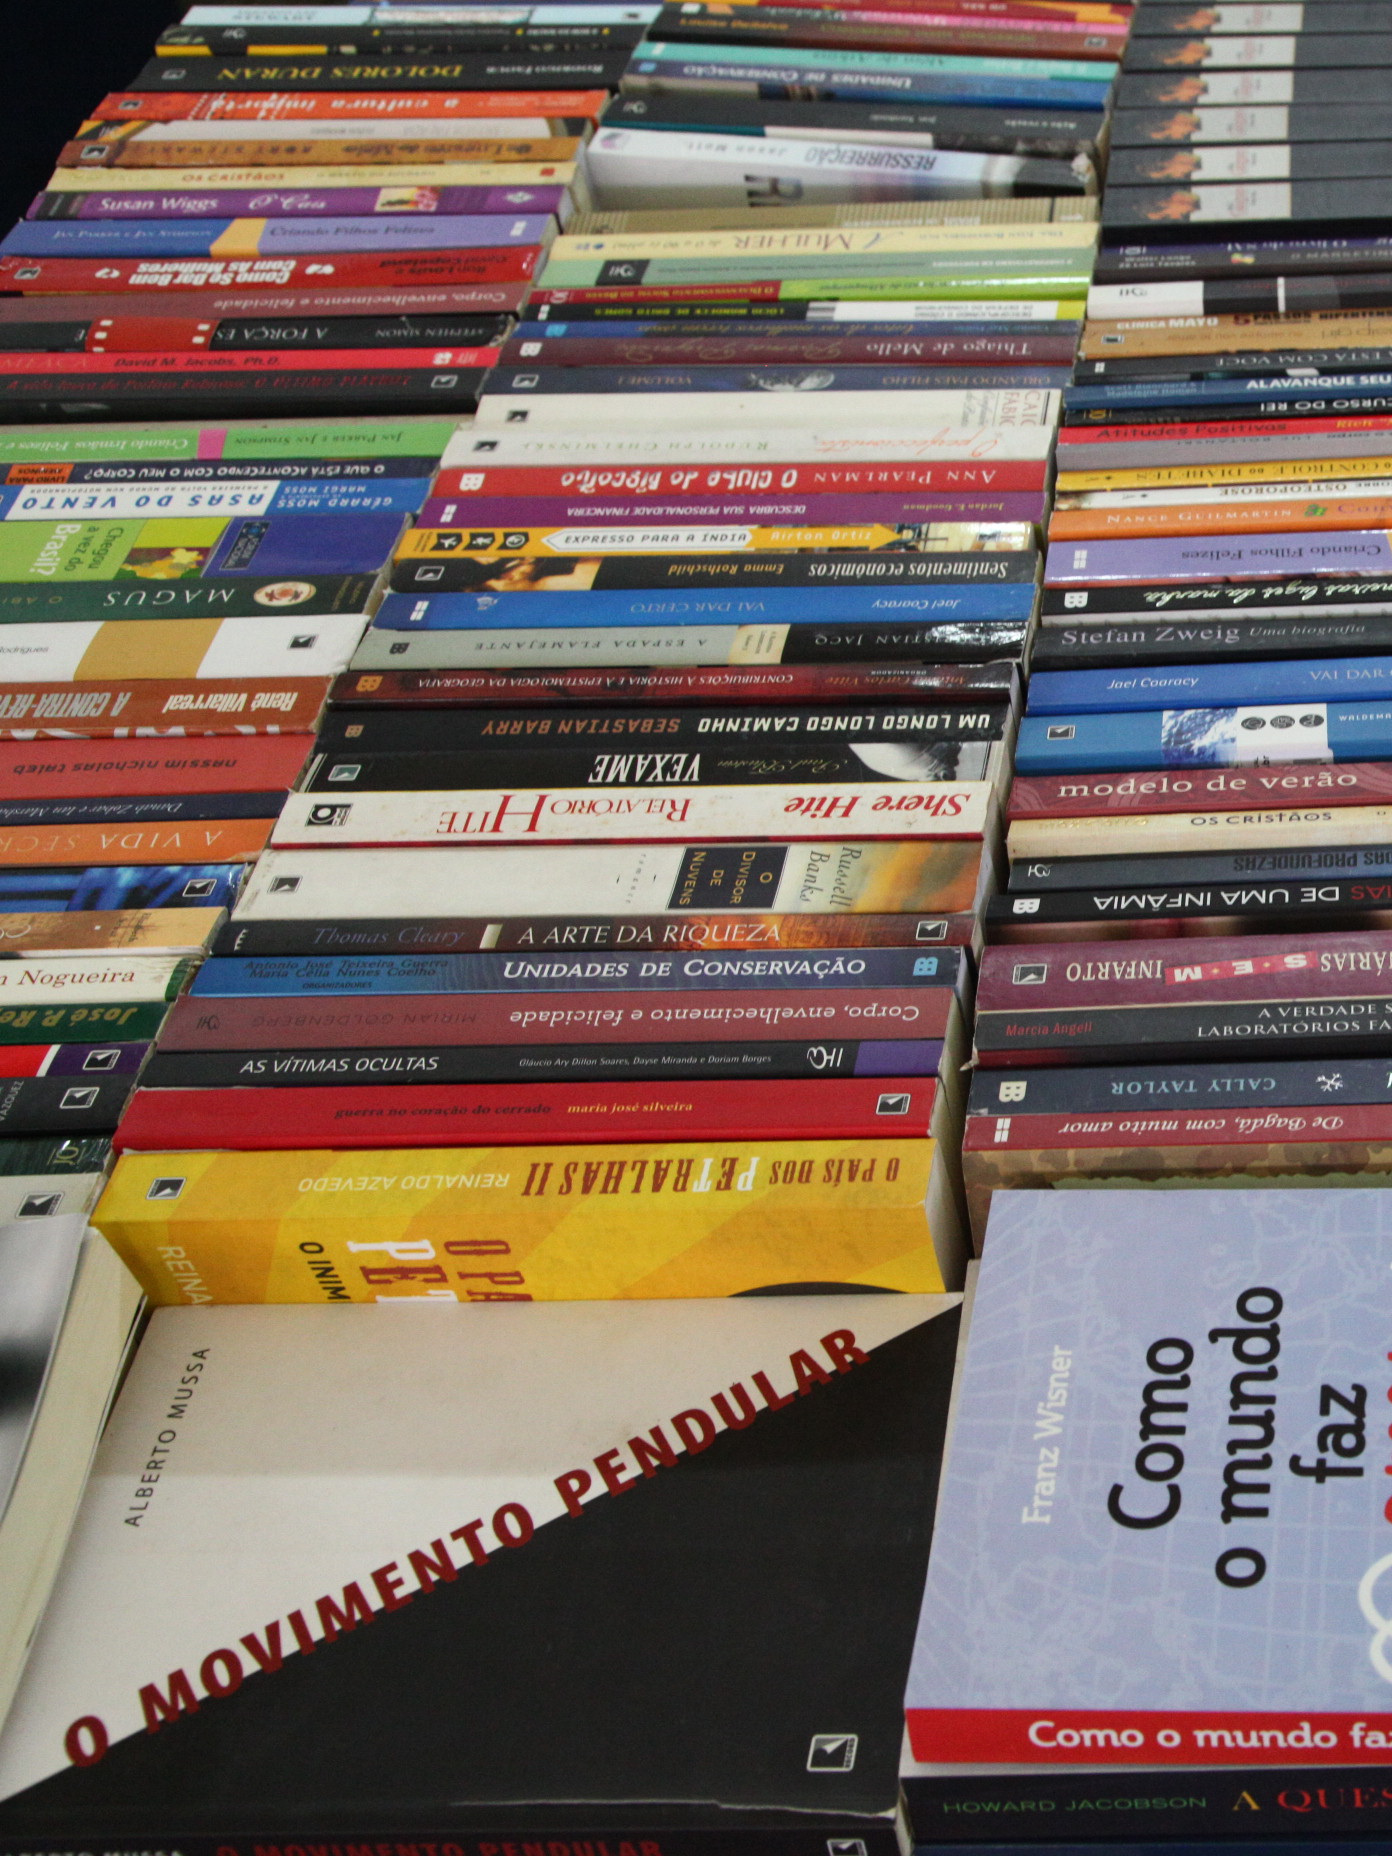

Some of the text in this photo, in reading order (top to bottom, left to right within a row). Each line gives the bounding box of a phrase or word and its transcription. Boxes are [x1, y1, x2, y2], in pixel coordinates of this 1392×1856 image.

[217, 64, 463, 80] DOLORES DURAN
[99, 196, 219, 213] Susan Wiggs
[866, 340, 1032, 356] Thiago de Mello
[1245, 372, 1356, 391] ALAVANQUE
[1359, 374, 1392, 386] SEU
[83, 464, 385, 480] O QUE ESTÁ ACONTECENDO COM O MEU CORPO?
[814, 469, 996, 484] ANN PEARLMAN
[22, 493, 264, 510] ASAS DO VENTO
[1106, 509, 1291, 524] NANCE GUILMARTIN
[564, 532, 747, 544] EXPRESSO PARA A ÍNDIA
[28, 524, 82, 576] Brasil?
[808, 561, 1008, 579] Sentimentos econômicos
[103, 588, 235, 606] MAGUS
[1061, 625, 1240, 645] Stefan Zweig
[161, 691, 298, 713] René Villarreal
[481, 718, 681, 735] SEBASTIAN BARRY
[697, 714, 990, 733] UM LONGO LONGO CAMINHO
[588, 753, 700, 783] VEXAME
[1057, 771, 1357, 797] modelo de verão
[783, 793, 971, 819] Shere Hite
[679, 851, 707, 906] NUVENS
[710, 870, 724, 886] DE
[729, 851, 756, 904] DIVISOR
[760, 872, 773, 883] O
[517, 924, 780, 945] A ARTE DA RIQUEZA
[17, 967, 135, 987] Nogueira
[503, 956, 866, 979] UNIDADES DE CONSERVAÇÃO
[239, 1055, 439, 1073] AS VÍTIMAS OCULTAS
[297, 1172, 510, 1192] REINALDO AZEVEDO
[521, 1156, 758, 1196] PETRALHAS II
[124, 1346, 213, 1528] ALBERTO MUSSA
[1021, 1344, 1072, 1524] Franz Wisner
[1107, 1335, 1195, 1530] Como
[1209, 1285, 1285, 1589] o mundo
[1289, 1382, 1367, 1484] faz
[64, 1327, 870, 1768] O MOVIMENTO PENDULAR
[1027, 1720, 1144, 1748] Como
[1156, 1728, 1181, 1748] o
[1192, 1721, 1338, 1748] mundo
[1232, 1790, 1261, 1811] A
